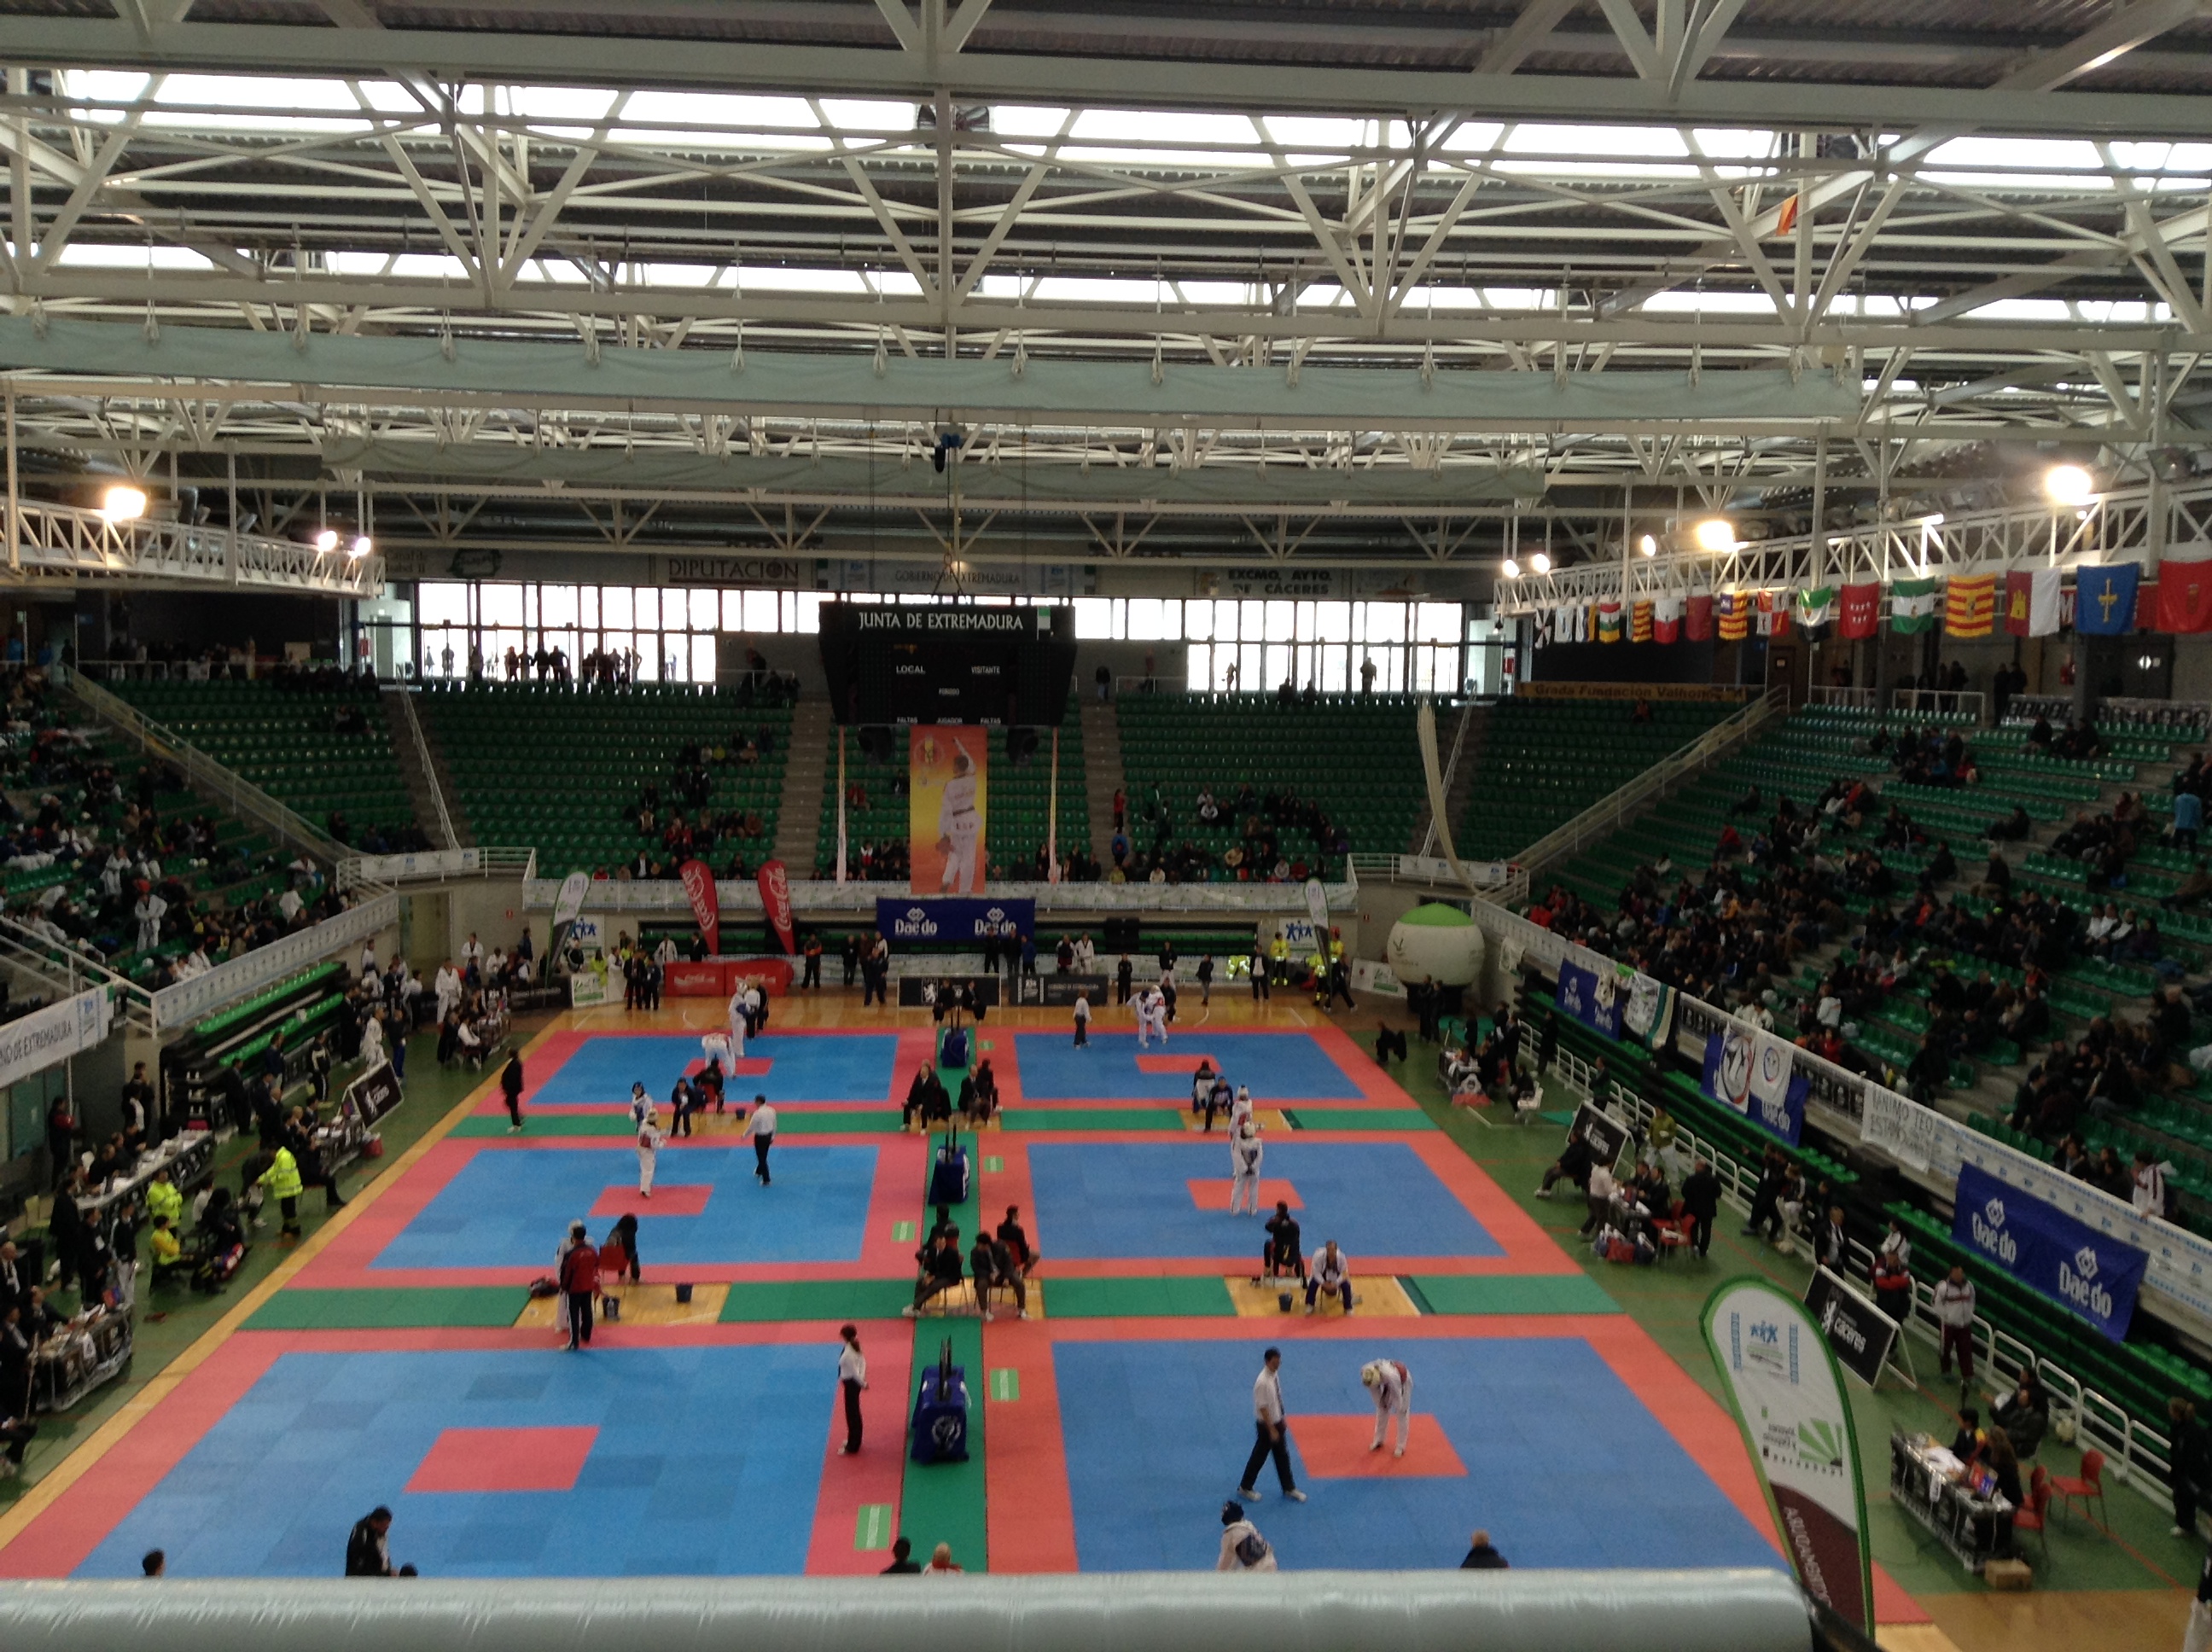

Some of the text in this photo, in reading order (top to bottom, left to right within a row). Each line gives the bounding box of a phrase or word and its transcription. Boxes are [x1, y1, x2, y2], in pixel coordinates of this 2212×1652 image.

[957, 572, 1020, 585] XTREMADURA
[859, 612, 1023, 631] JUNTA DE EXTREMADURA
[896, 666, 926, 674] LOCAL
[971, 666, 1000, 674] VISITANTE
